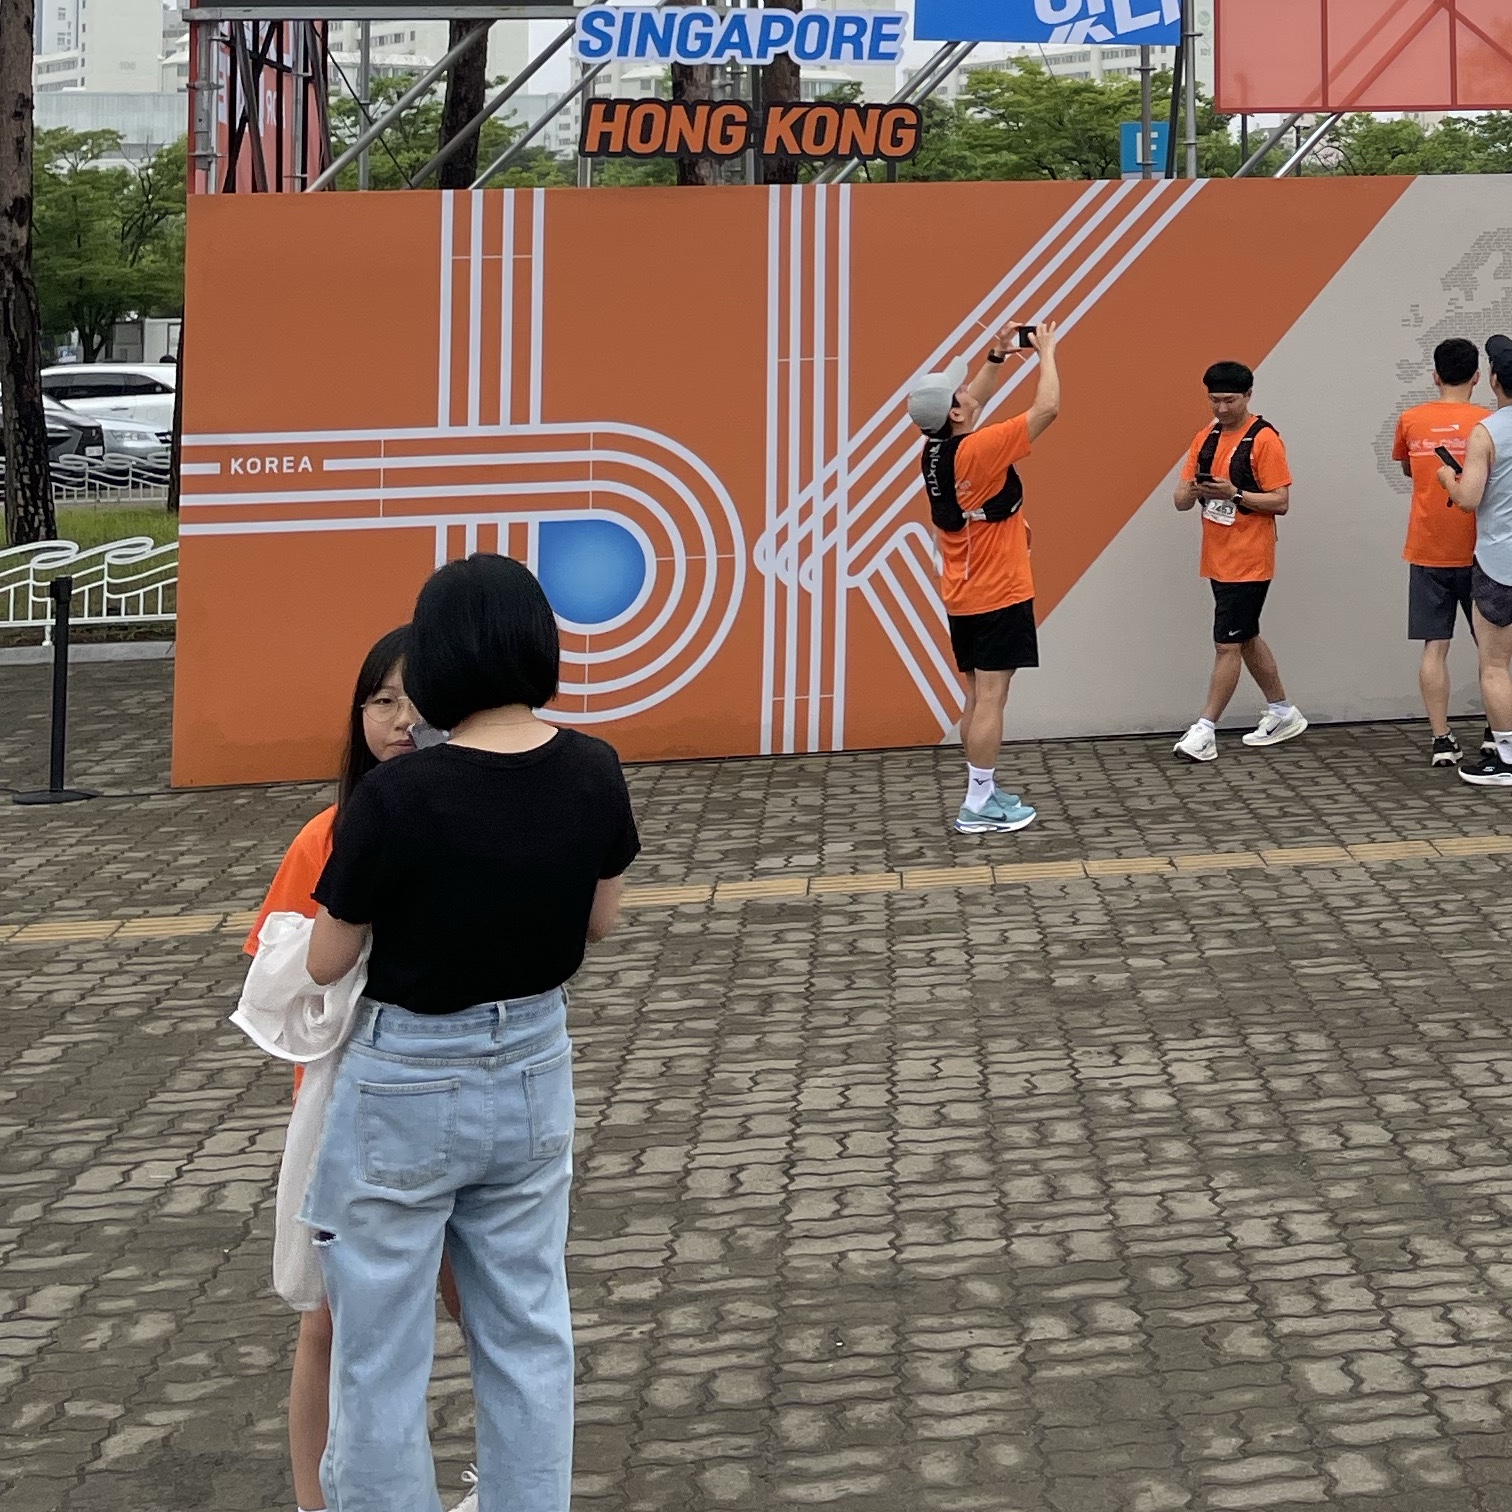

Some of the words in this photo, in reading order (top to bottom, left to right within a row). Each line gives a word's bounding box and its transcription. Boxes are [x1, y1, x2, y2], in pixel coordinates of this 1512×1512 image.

[578, 9, 903, 62] SINGAPORE
[584, 103, 748, 155] HONG
[762, 105, 918, 157] KONG
[230, 455, 313, 476] KOREA
